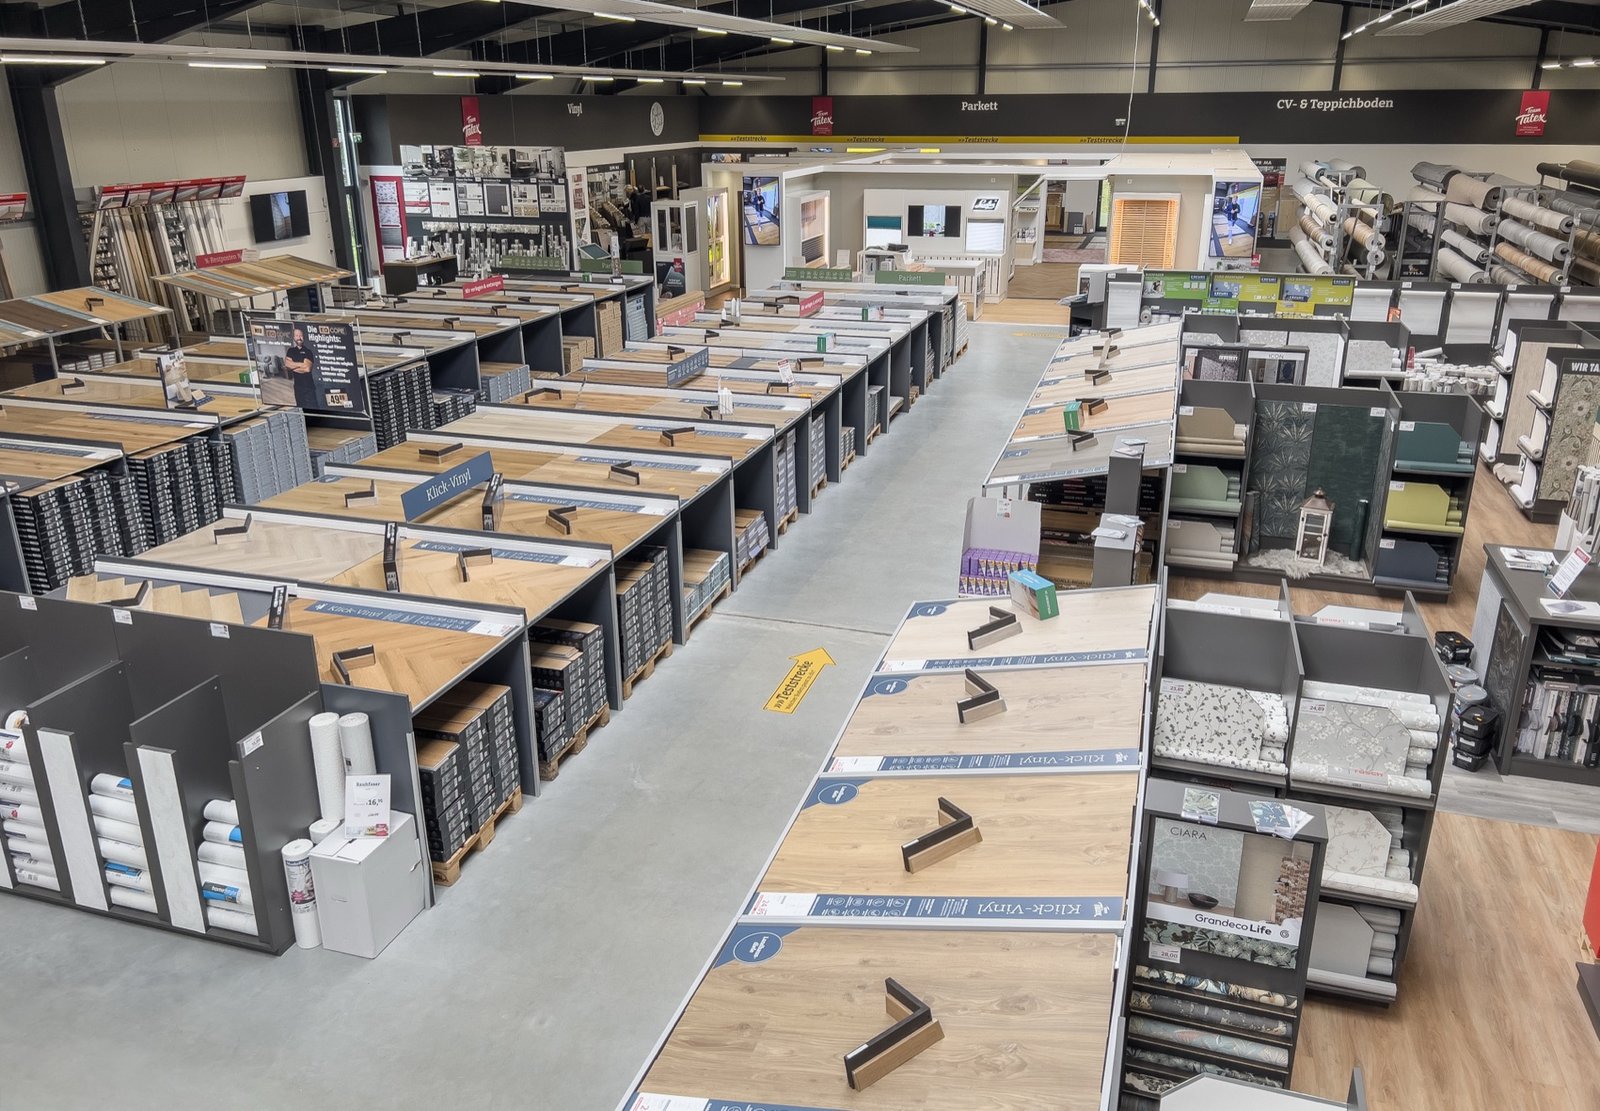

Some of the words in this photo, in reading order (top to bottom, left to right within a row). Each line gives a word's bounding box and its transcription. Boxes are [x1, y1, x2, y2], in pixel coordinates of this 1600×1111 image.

[567, 102, 583, 117] Vinyl
[961, 100, 999, 111] Parkett
[1276, 98, 1298, 110] CV-
[1300, 99, 1308, 110] &
[1310, 98, 1394, 112] Teppichboden
[1525, 106, 1542, 114] Team
[308, 333, 342, 343] Highlights:
[1571, 362, 1589, 372] WIR
[426, 468, 472, 502] Klick-Vinyl
[1042, 652, 1117, 664] Klick-Vinyl
[1018, 754, 1105, 766] Klick-Vinyl
[1170, 826, 1207, 841] CIARA
[977, 901, 1082, 915] Klick-Vinyl
